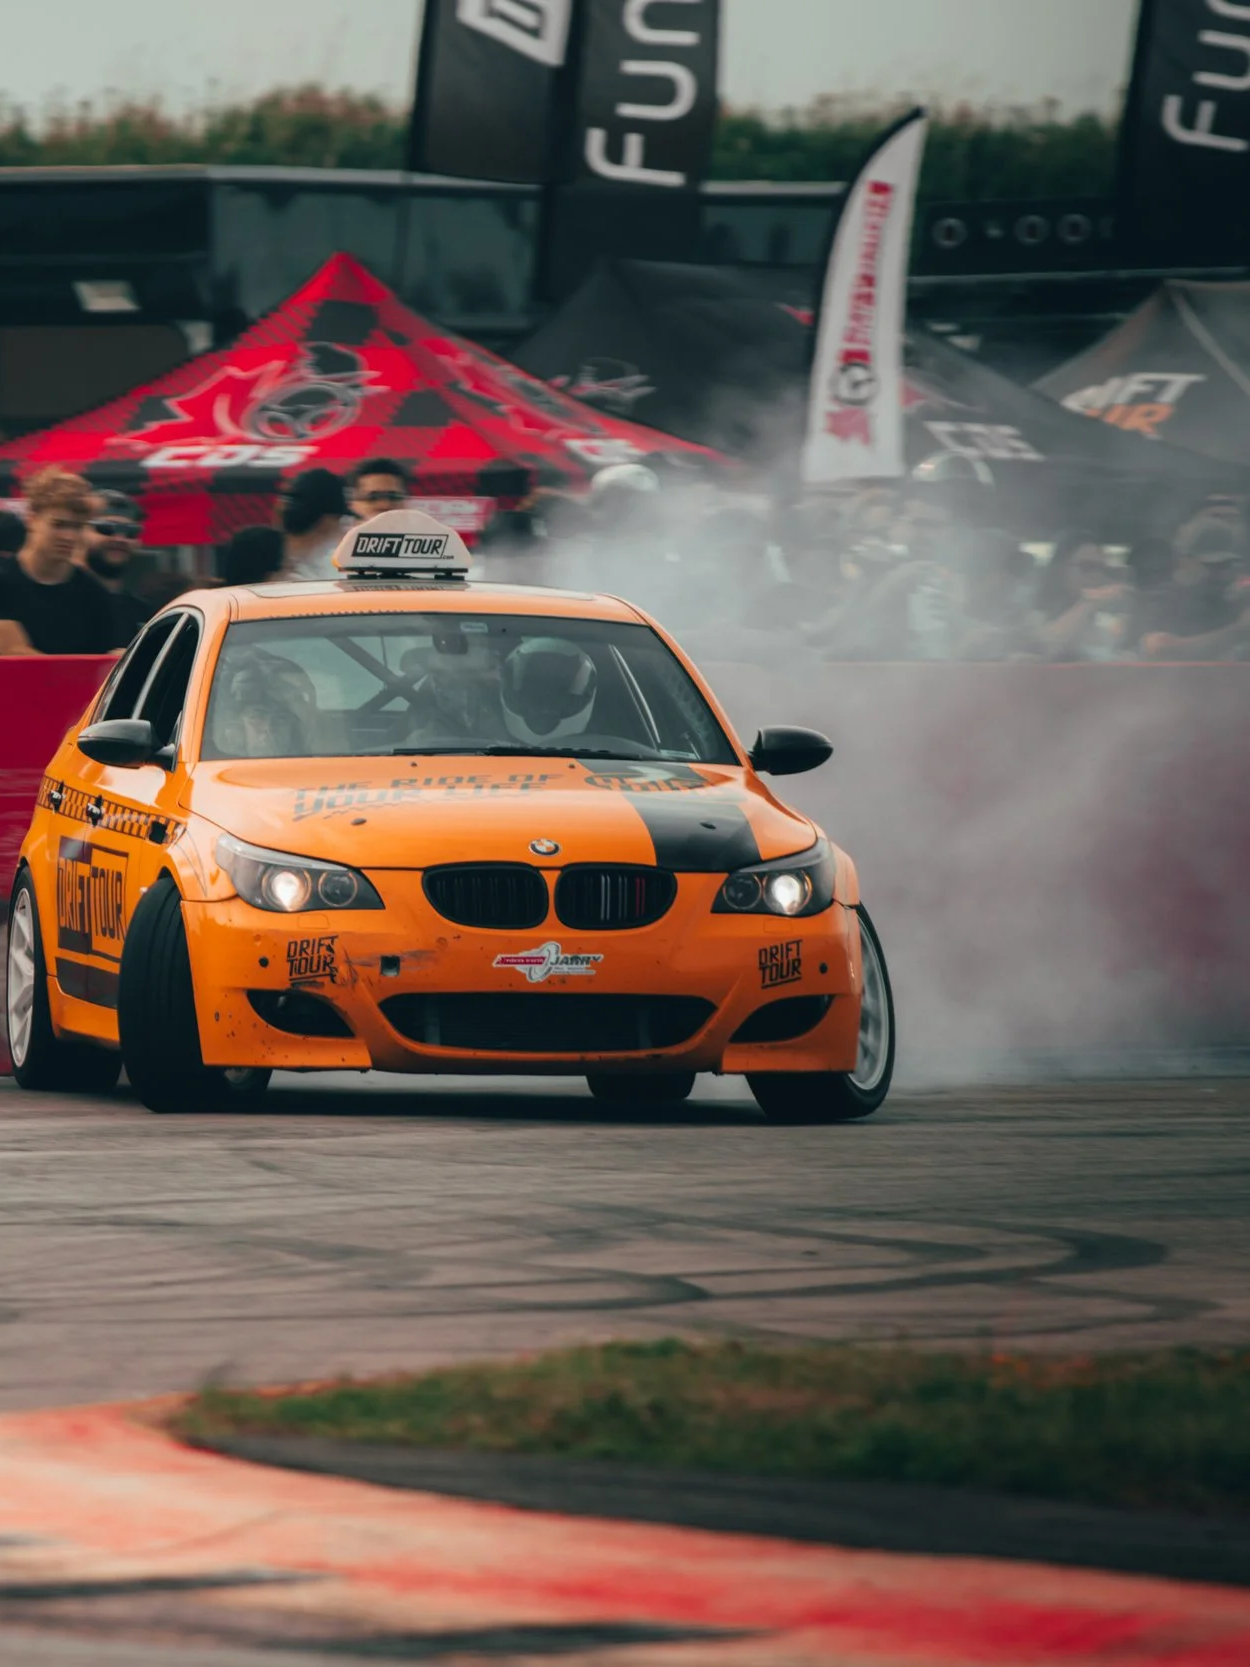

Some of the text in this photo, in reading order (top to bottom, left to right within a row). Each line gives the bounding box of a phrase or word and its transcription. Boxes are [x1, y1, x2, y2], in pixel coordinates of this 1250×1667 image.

[138, 445, 320, 468] CDS
[355, 536, 403, 554] DRIFT
[404, 538, 443, 555] TOUR
[296, 774, 564, 800] THE RIDE OF
[292, 782, 543, 821] YOUR LIFE
[58, 857, 126, 941] DRIFT TOUR
[286, 935, 339, 959] DRIFT
[758, 938, 803, 967] DRIFT
[286, 954, 336, 976] TOUR
[758, 958, 802, 984] TOUR
